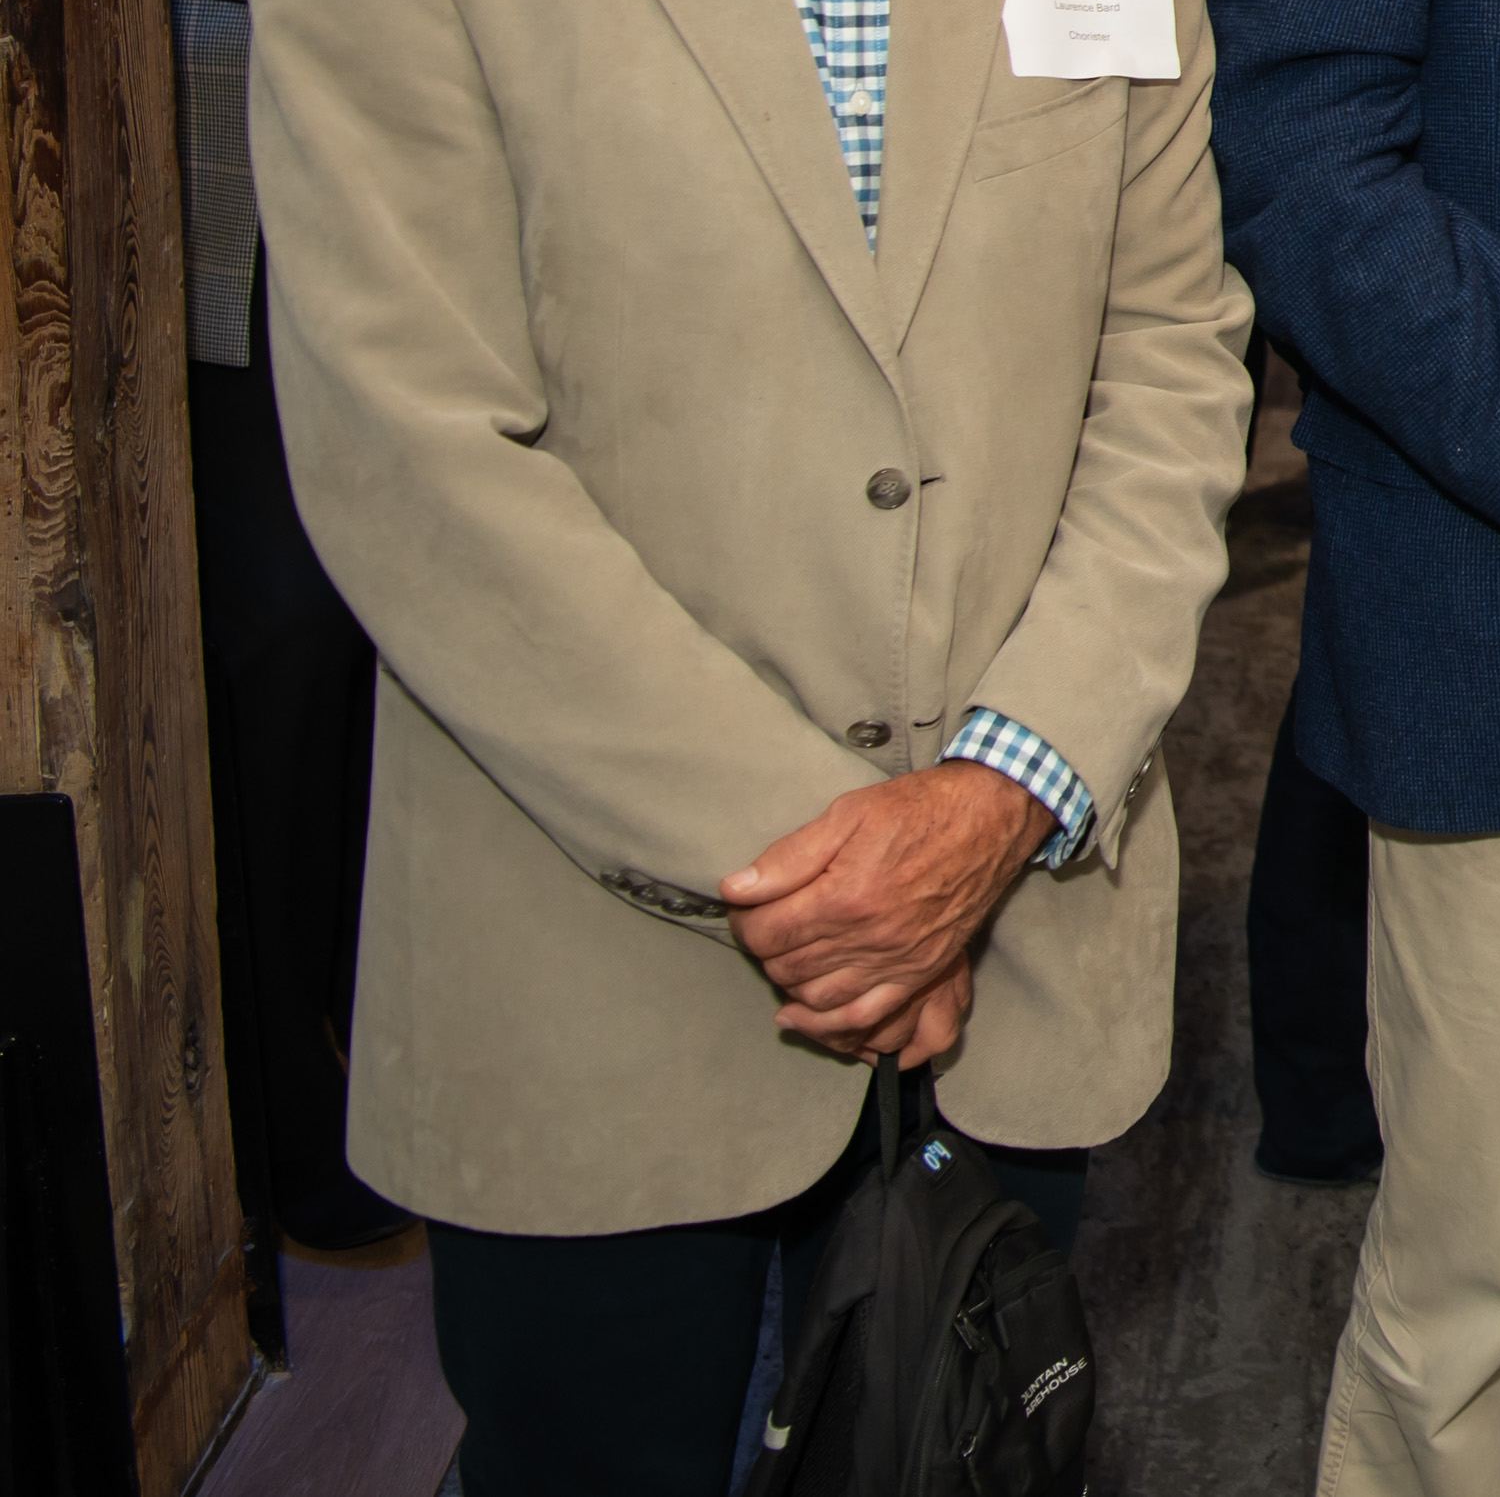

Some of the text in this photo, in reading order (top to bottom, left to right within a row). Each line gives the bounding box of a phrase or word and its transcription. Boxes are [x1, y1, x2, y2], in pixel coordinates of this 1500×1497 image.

[1053, 0, 1121, 13] Laurence Bard
[1068, 30, 1111, 42] Chorister
